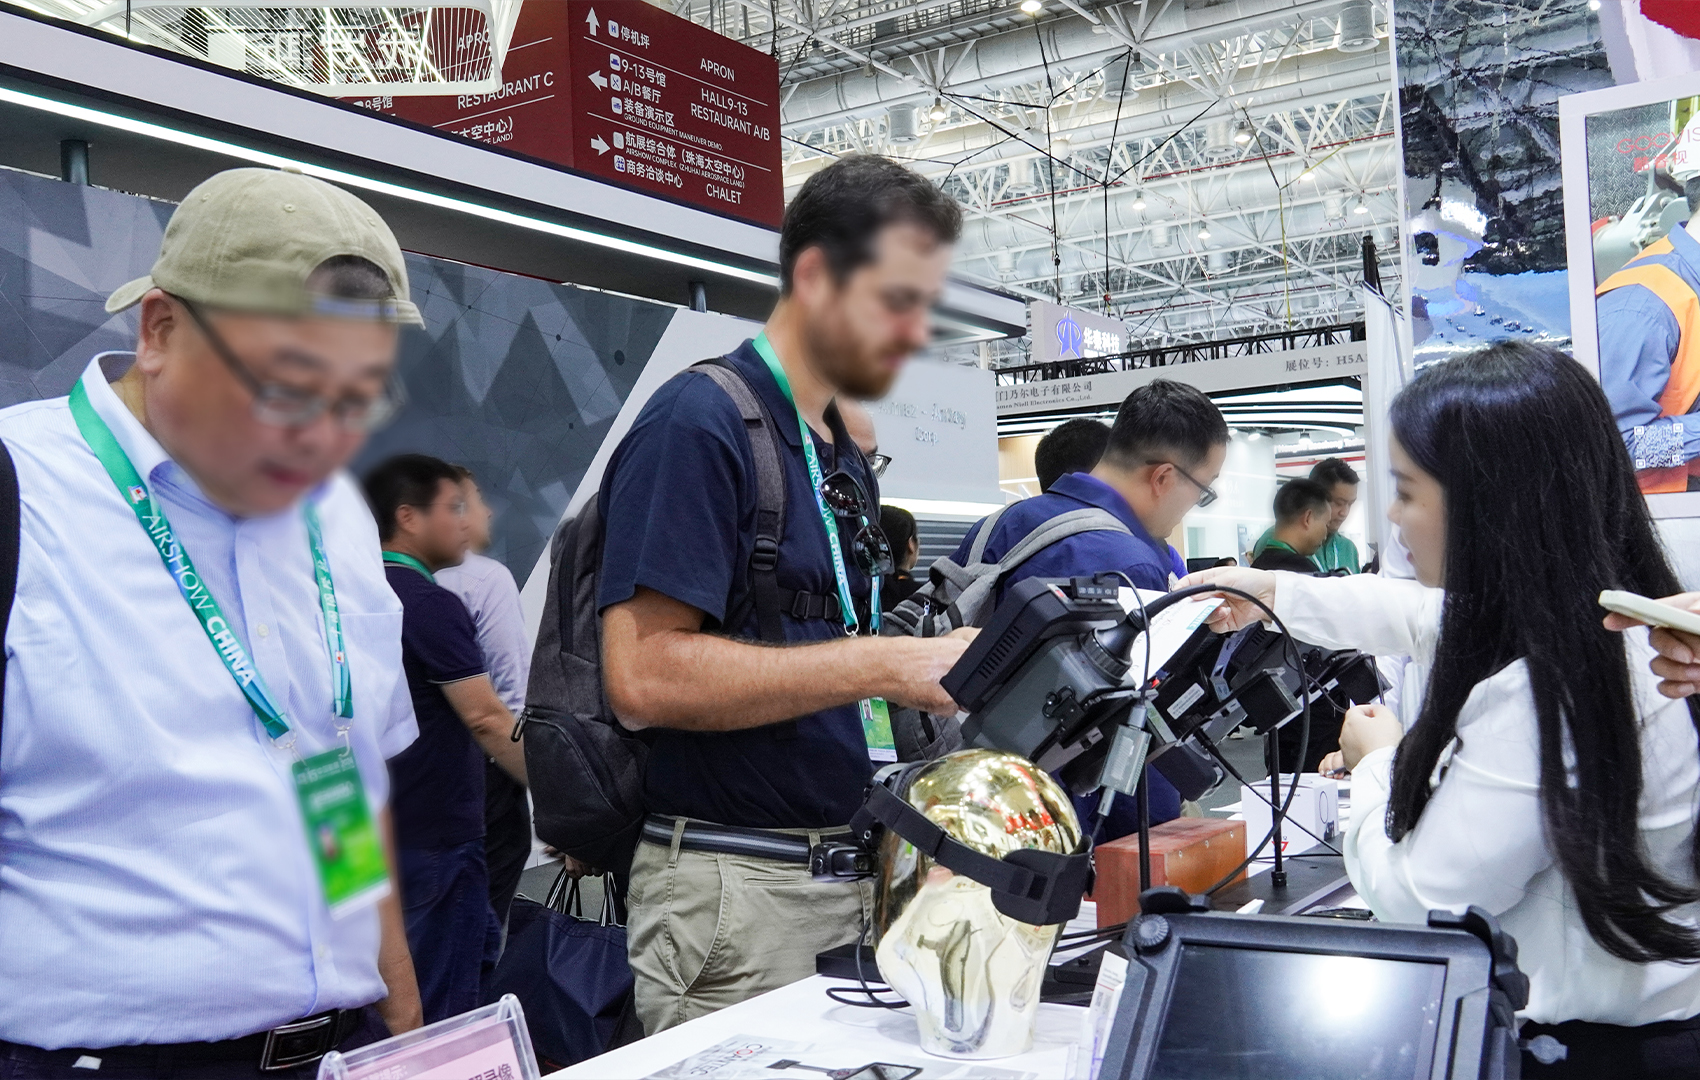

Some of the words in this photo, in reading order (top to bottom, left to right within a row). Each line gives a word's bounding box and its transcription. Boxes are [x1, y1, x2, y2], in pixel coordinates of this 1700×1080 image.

[457, 30, 490, 50] APRO
[621, 25, 650, 50] 停机坪
[622, 59, 666, 88] 9-13号馆
[700, 58, 735, 82] APRON
[458, 74, 540, 110] RESTAURANT
[544, 72, 554, 86] C
[623, 80, 661, 104] A/B餐厅
[624, 97, 674, 127] 装备演示区
[690, 103, 751, 135] RESTAURANT
[754, 126, 770, 141] A/B
[624, 113, 648, 126] GROUND
[648, 120, 678, 136] EQUIPMENT
[626, 147, 651, 161] AIRSHOW
[626, 159, 683, 188] 商务洽谈中心
[706, 183, 742, 204] CHALET
[1336, 353, 1368, 366] H5A
[996, 381, 1092, 402] 门乃尔电子有限公司
[829, 532, 846, 585] CHINA
[142, 514, 214, 611] AIRSHOW
[206, 616, 256, 688] CHINA
